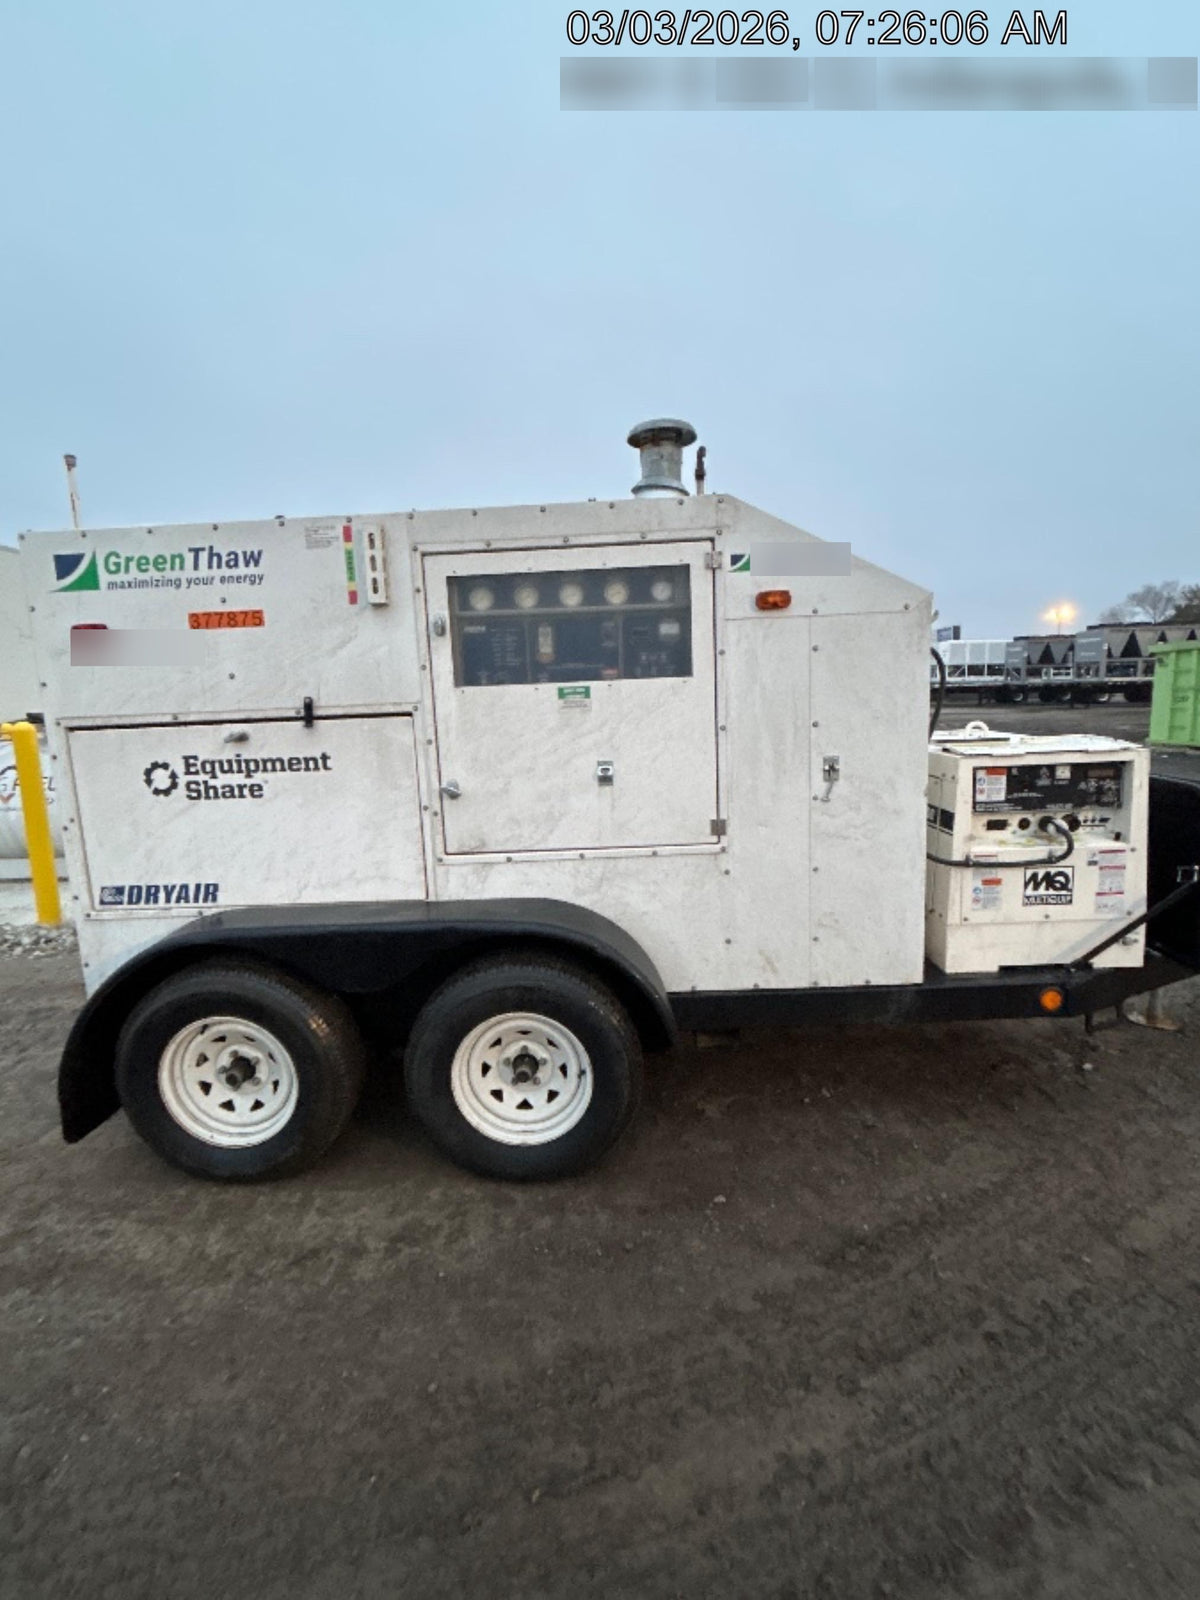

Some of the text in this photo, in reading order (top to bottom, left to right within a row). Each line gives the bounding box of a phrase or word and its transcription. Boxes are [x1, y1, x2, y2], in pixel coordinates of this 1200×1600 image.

[103, 546, 263, 575] GreenThaw
[107, 573, 265, 590] maximizing your energy
[190, 611, 263, 629] 377875
[182, 752, 332, 779] Equipment
[185, 780, 264, 801] Share
[1024, 870, 1073, 892] MQ
[126, 882, 219, 906] DRYAIR
